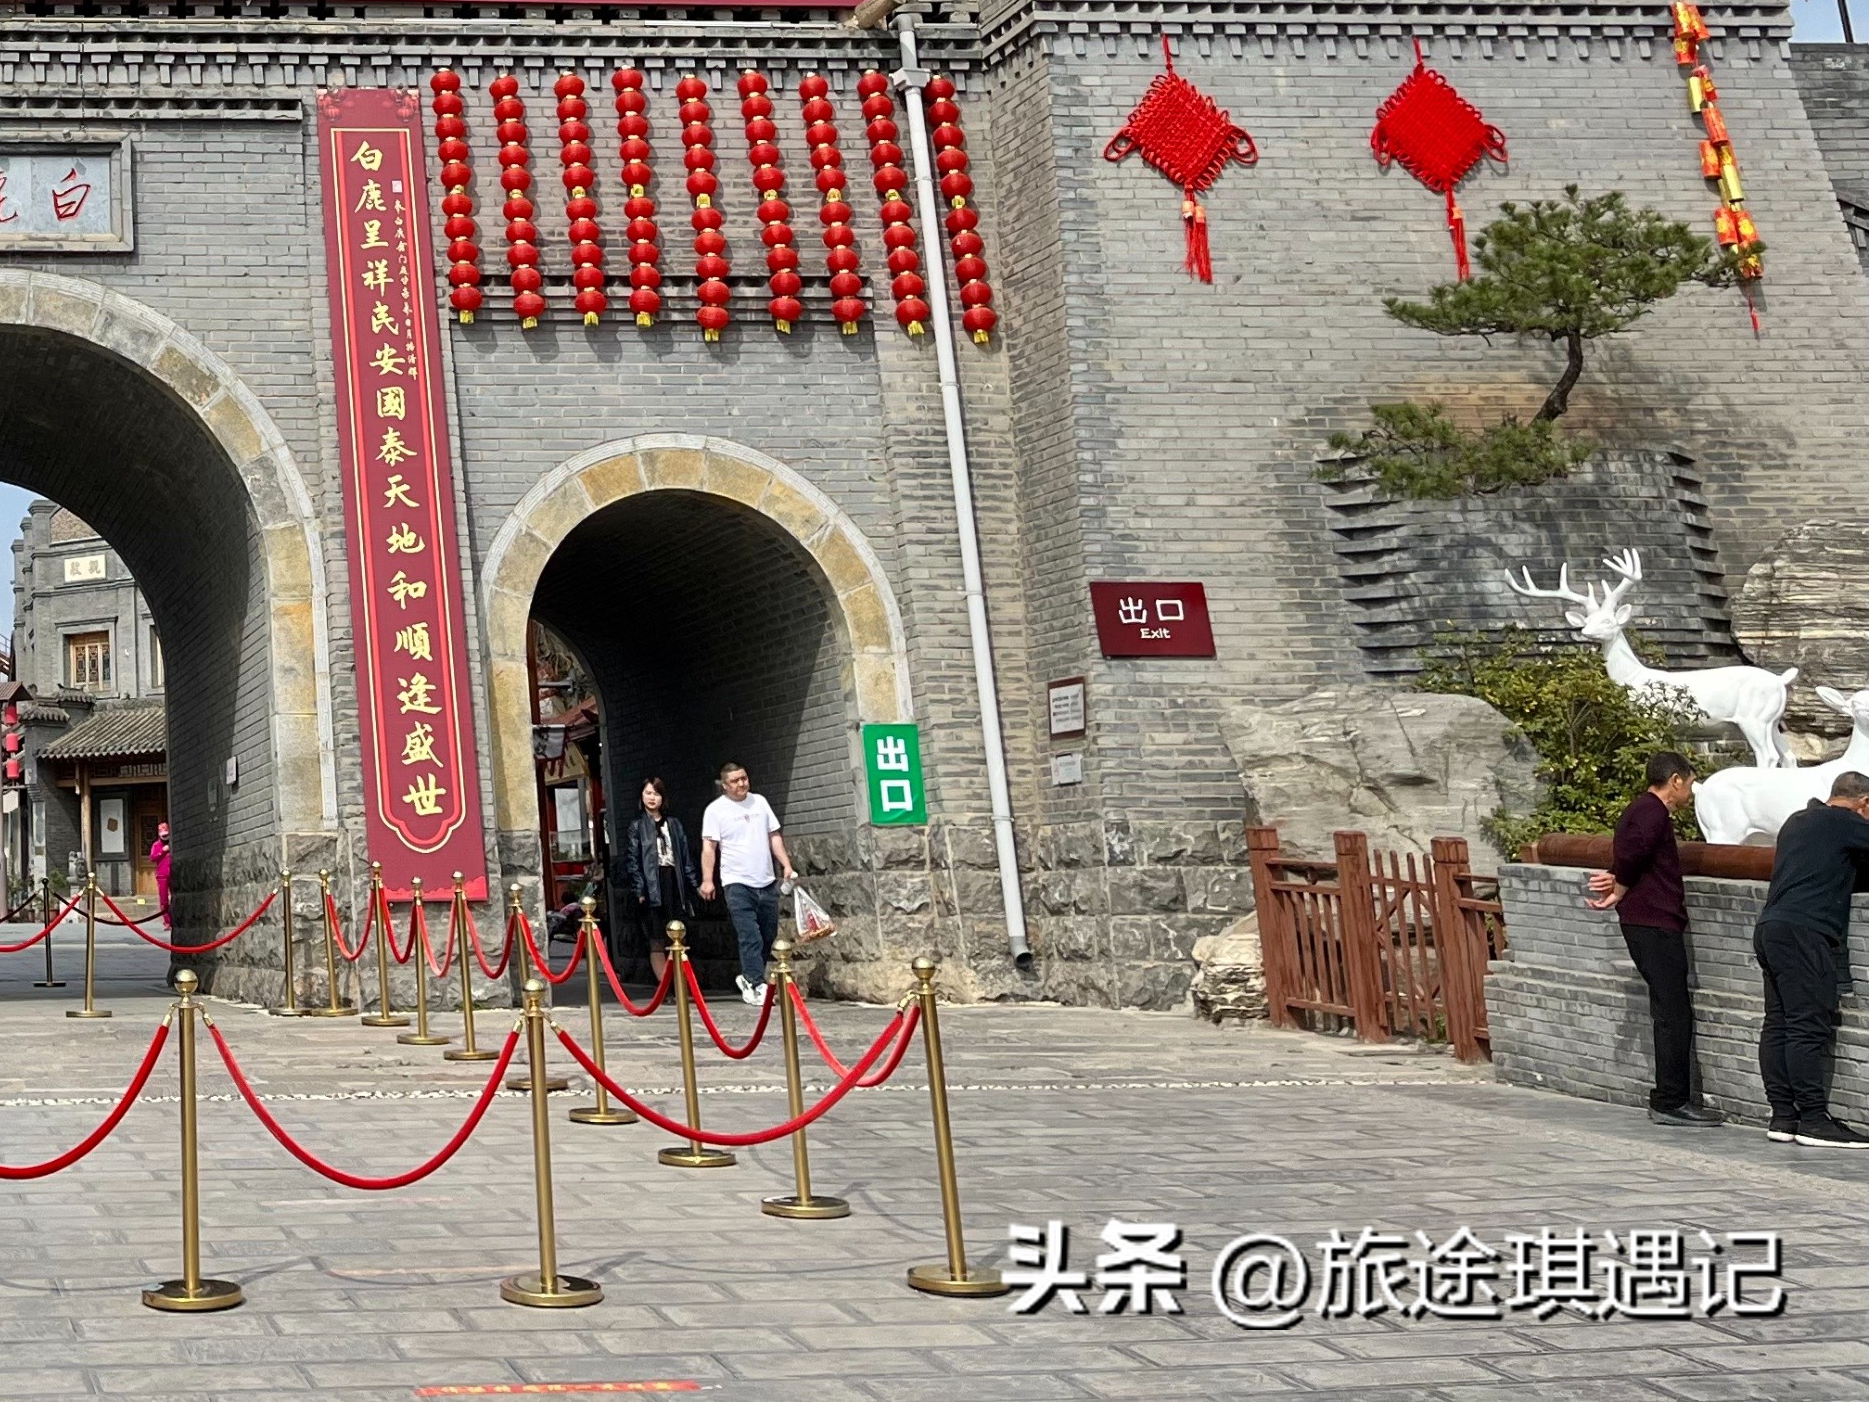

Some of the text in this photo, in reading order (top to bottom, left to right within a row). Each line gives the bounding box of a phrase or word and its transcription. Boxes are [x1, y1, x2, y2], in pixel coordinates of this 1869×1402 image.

[1118, 597, 1184, 623] 出口
[1140, 628, 1171, 639] Exit
[876, 736, 913, 812] 出口
